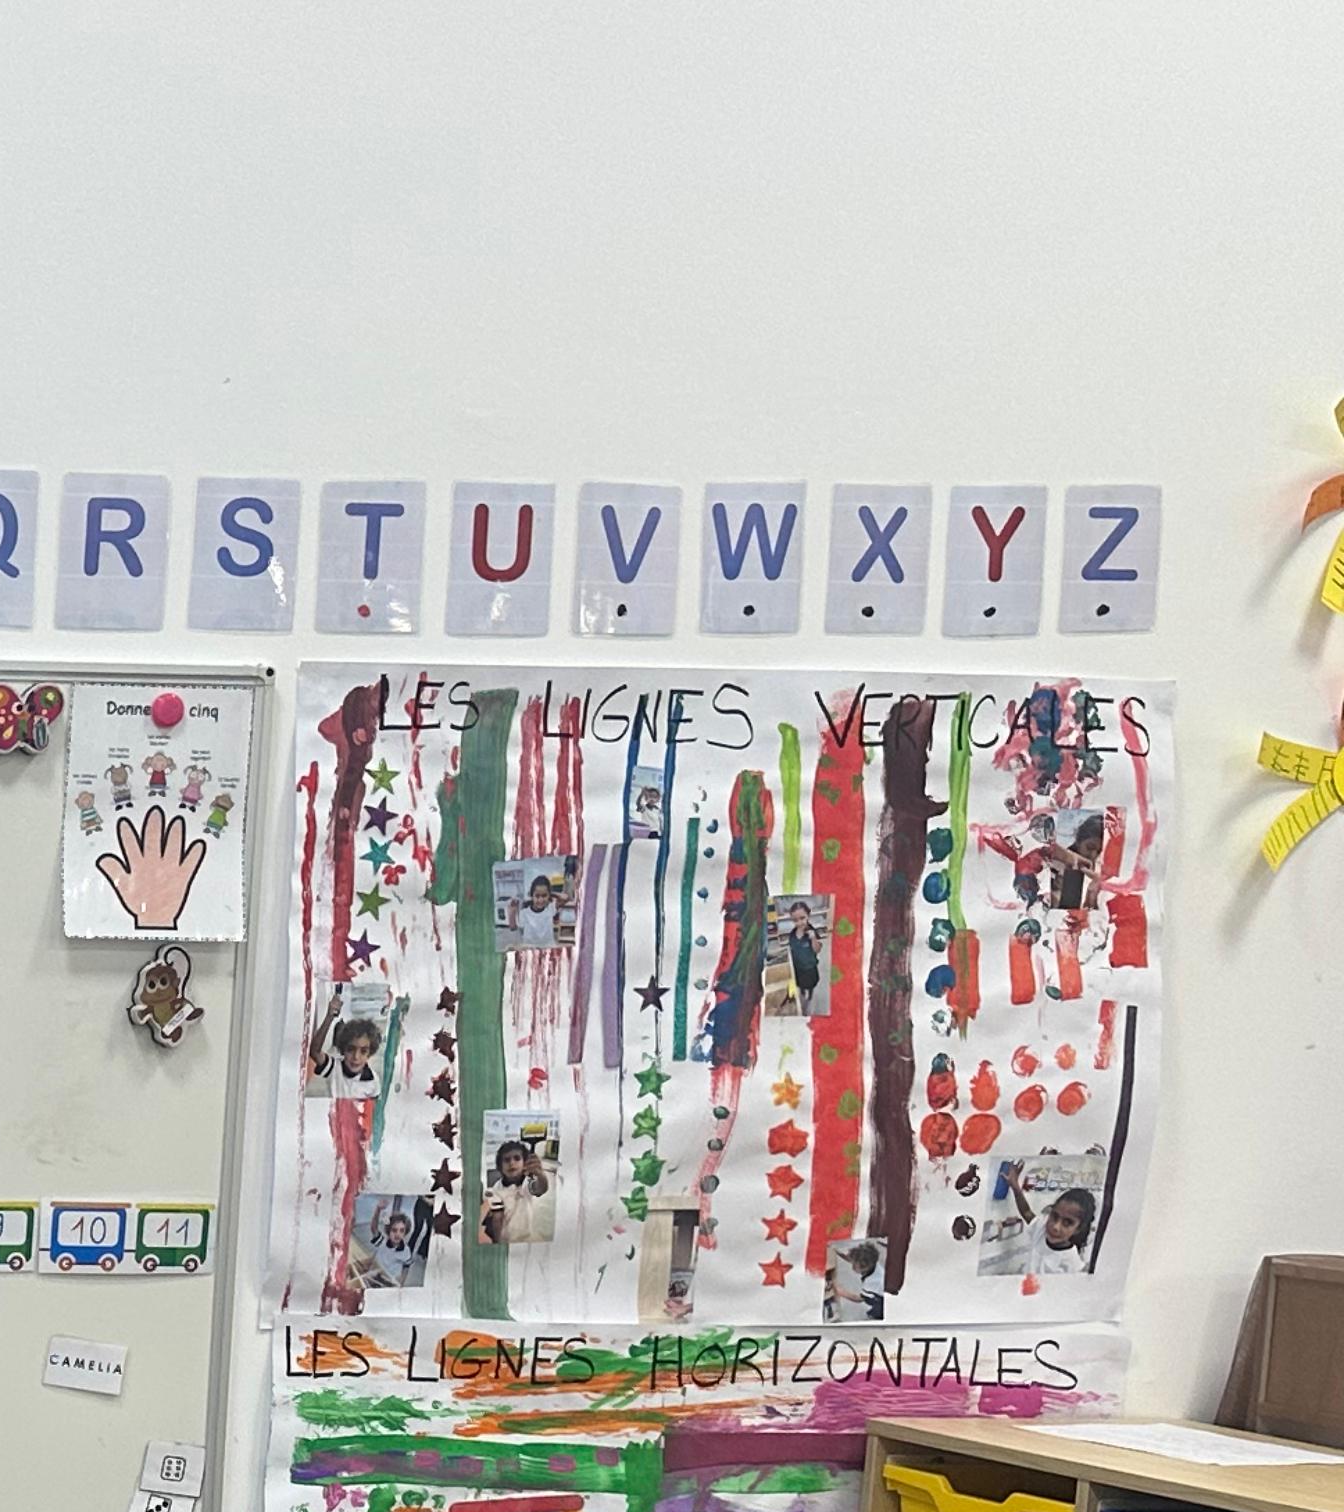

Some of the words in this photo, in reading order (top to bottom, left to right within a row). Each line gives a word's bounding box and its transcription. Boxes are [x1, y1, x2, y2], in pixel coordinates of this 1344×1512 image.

[84, 496, 146, 577] R
[217, 496, 275, 577] S
[345, 503, 405, 580] T
[473, 503, 532, 581] U
[601, 505, 661, 584] V
[713, 503, 798, 581] W
[852, 506, 907, 584] X
[972, 506, 1026, 582] Y
[1082, 507, 1140, 581] Z
[189, 703, 219, 723] cinq
[379, 673, 480, 731] LES
[543, 681, 756, 751] LIGNES
[815, 682, 1151, 757] VERTICALES
[70, 1217, 107, 1245] 10
[156, 1218, 190, 1245] 11
[49, 1354, 123, 1376] CAMELIA
[284, 1325, 370, 1381] LES
[406, 1326, 594, 1386] LIGNES
[651, 1335, 1079, 1391] HORIZONTALES
